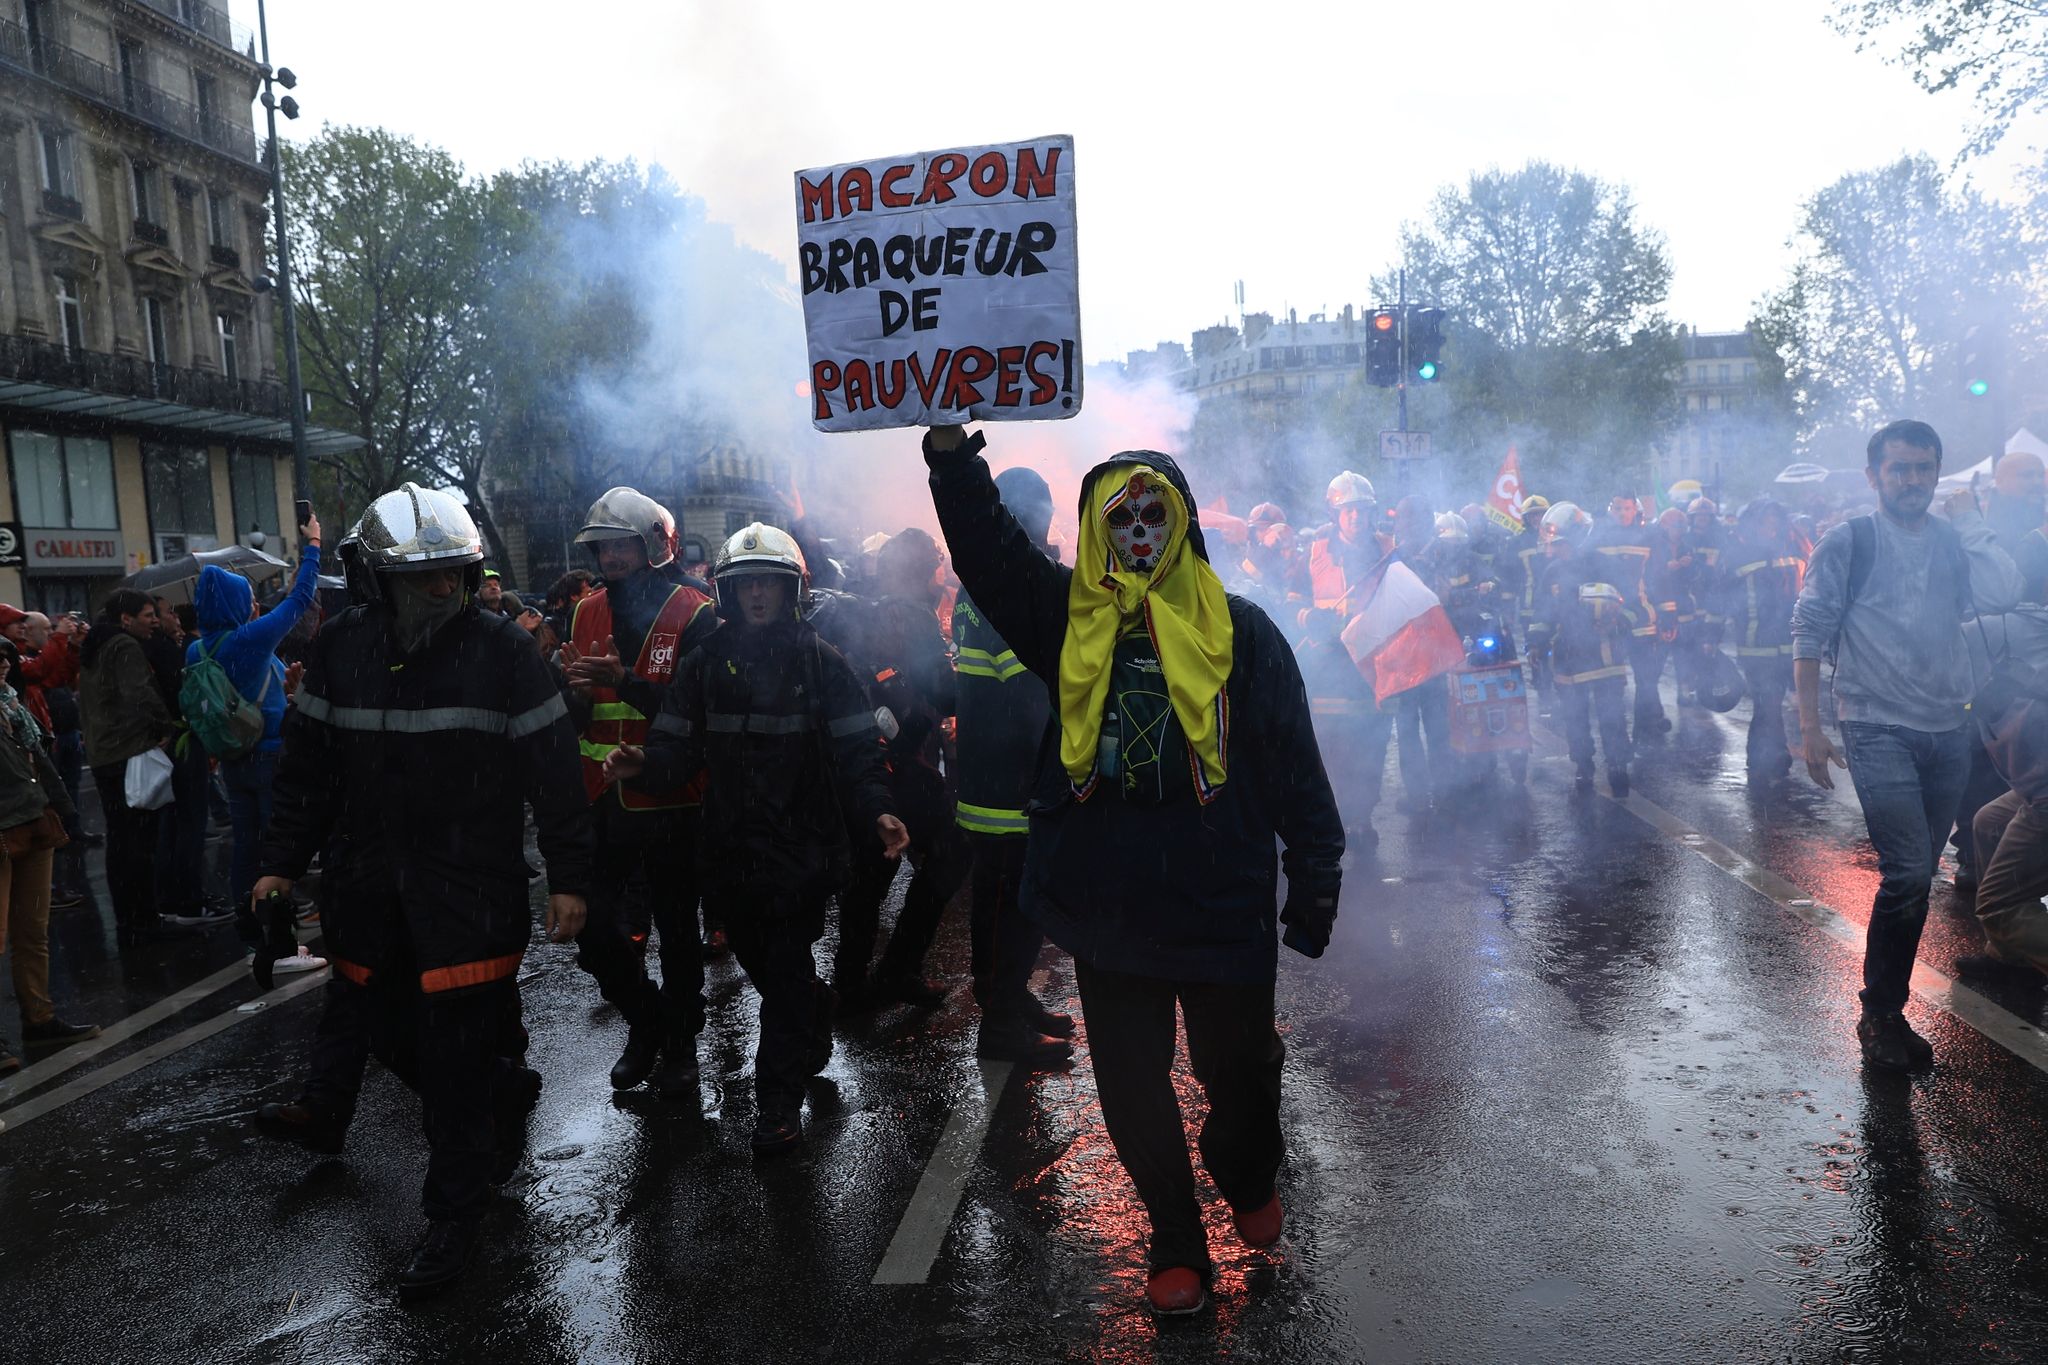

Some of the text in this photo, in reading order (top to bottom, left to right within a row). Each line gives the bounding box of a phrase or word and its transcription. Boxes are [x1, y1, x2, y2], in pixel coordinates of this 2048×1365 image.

[800, 147, 1062, 223] MACRON
[800, 221, 1057, 295] BRAQUEUR
[879, 287, 942, 337] DE
[812, 338, 1075, 420] PAUVRES!
[650, 646, 673, 664] cgt
